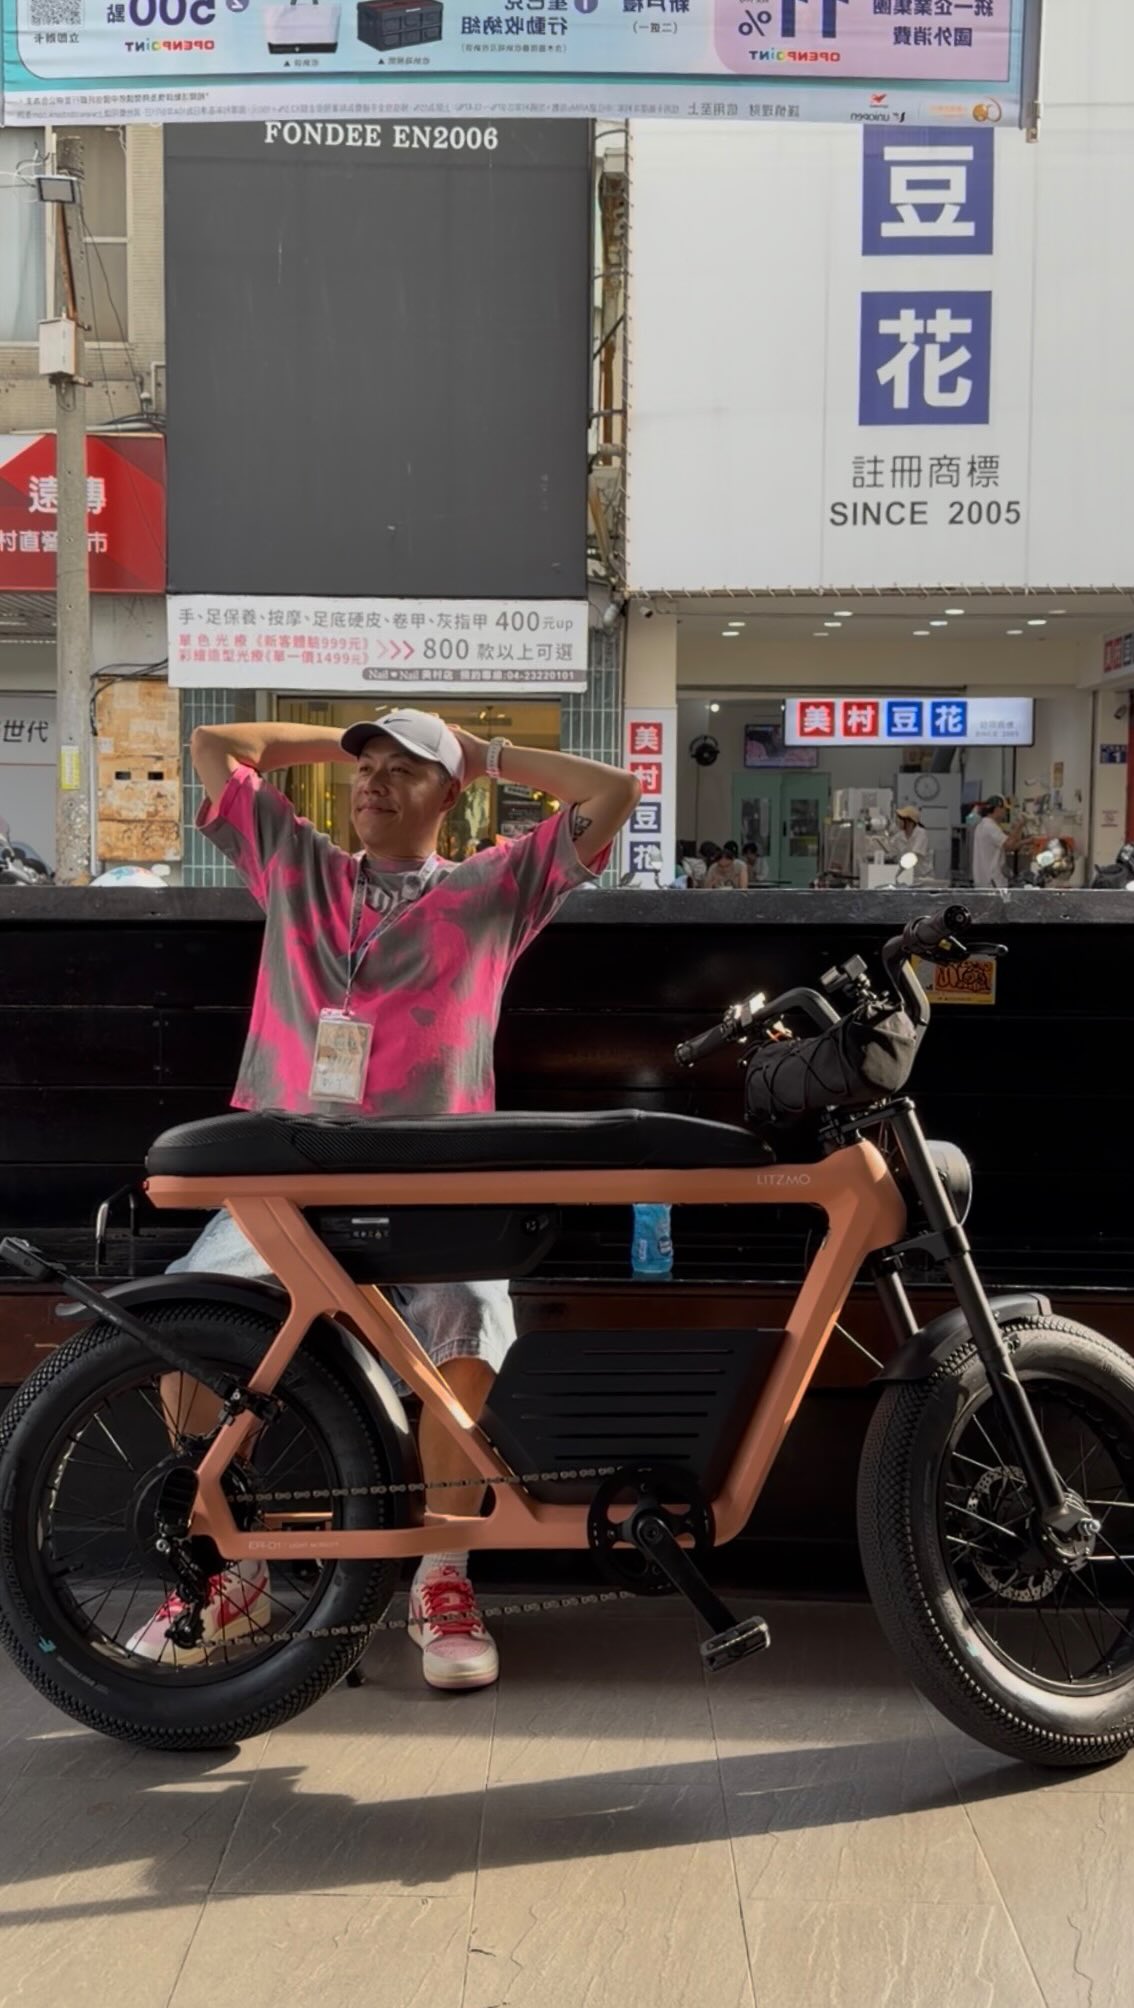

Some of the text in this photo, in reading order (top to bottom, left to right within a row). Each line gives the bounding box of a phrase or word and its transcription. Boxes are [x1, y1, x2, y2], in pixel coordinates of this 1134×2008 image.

[264, 121, 499, 151] FONDEE EN2006
[852, 454, 1000, 489] 註冊商標
[829, 500, 1021, 527] SINCE 2005
[423, 638, 573, 661] 800 款以上可選
[3, 719, 49, 743] 世代
[803, 703, 965, 736] 美村豆花
